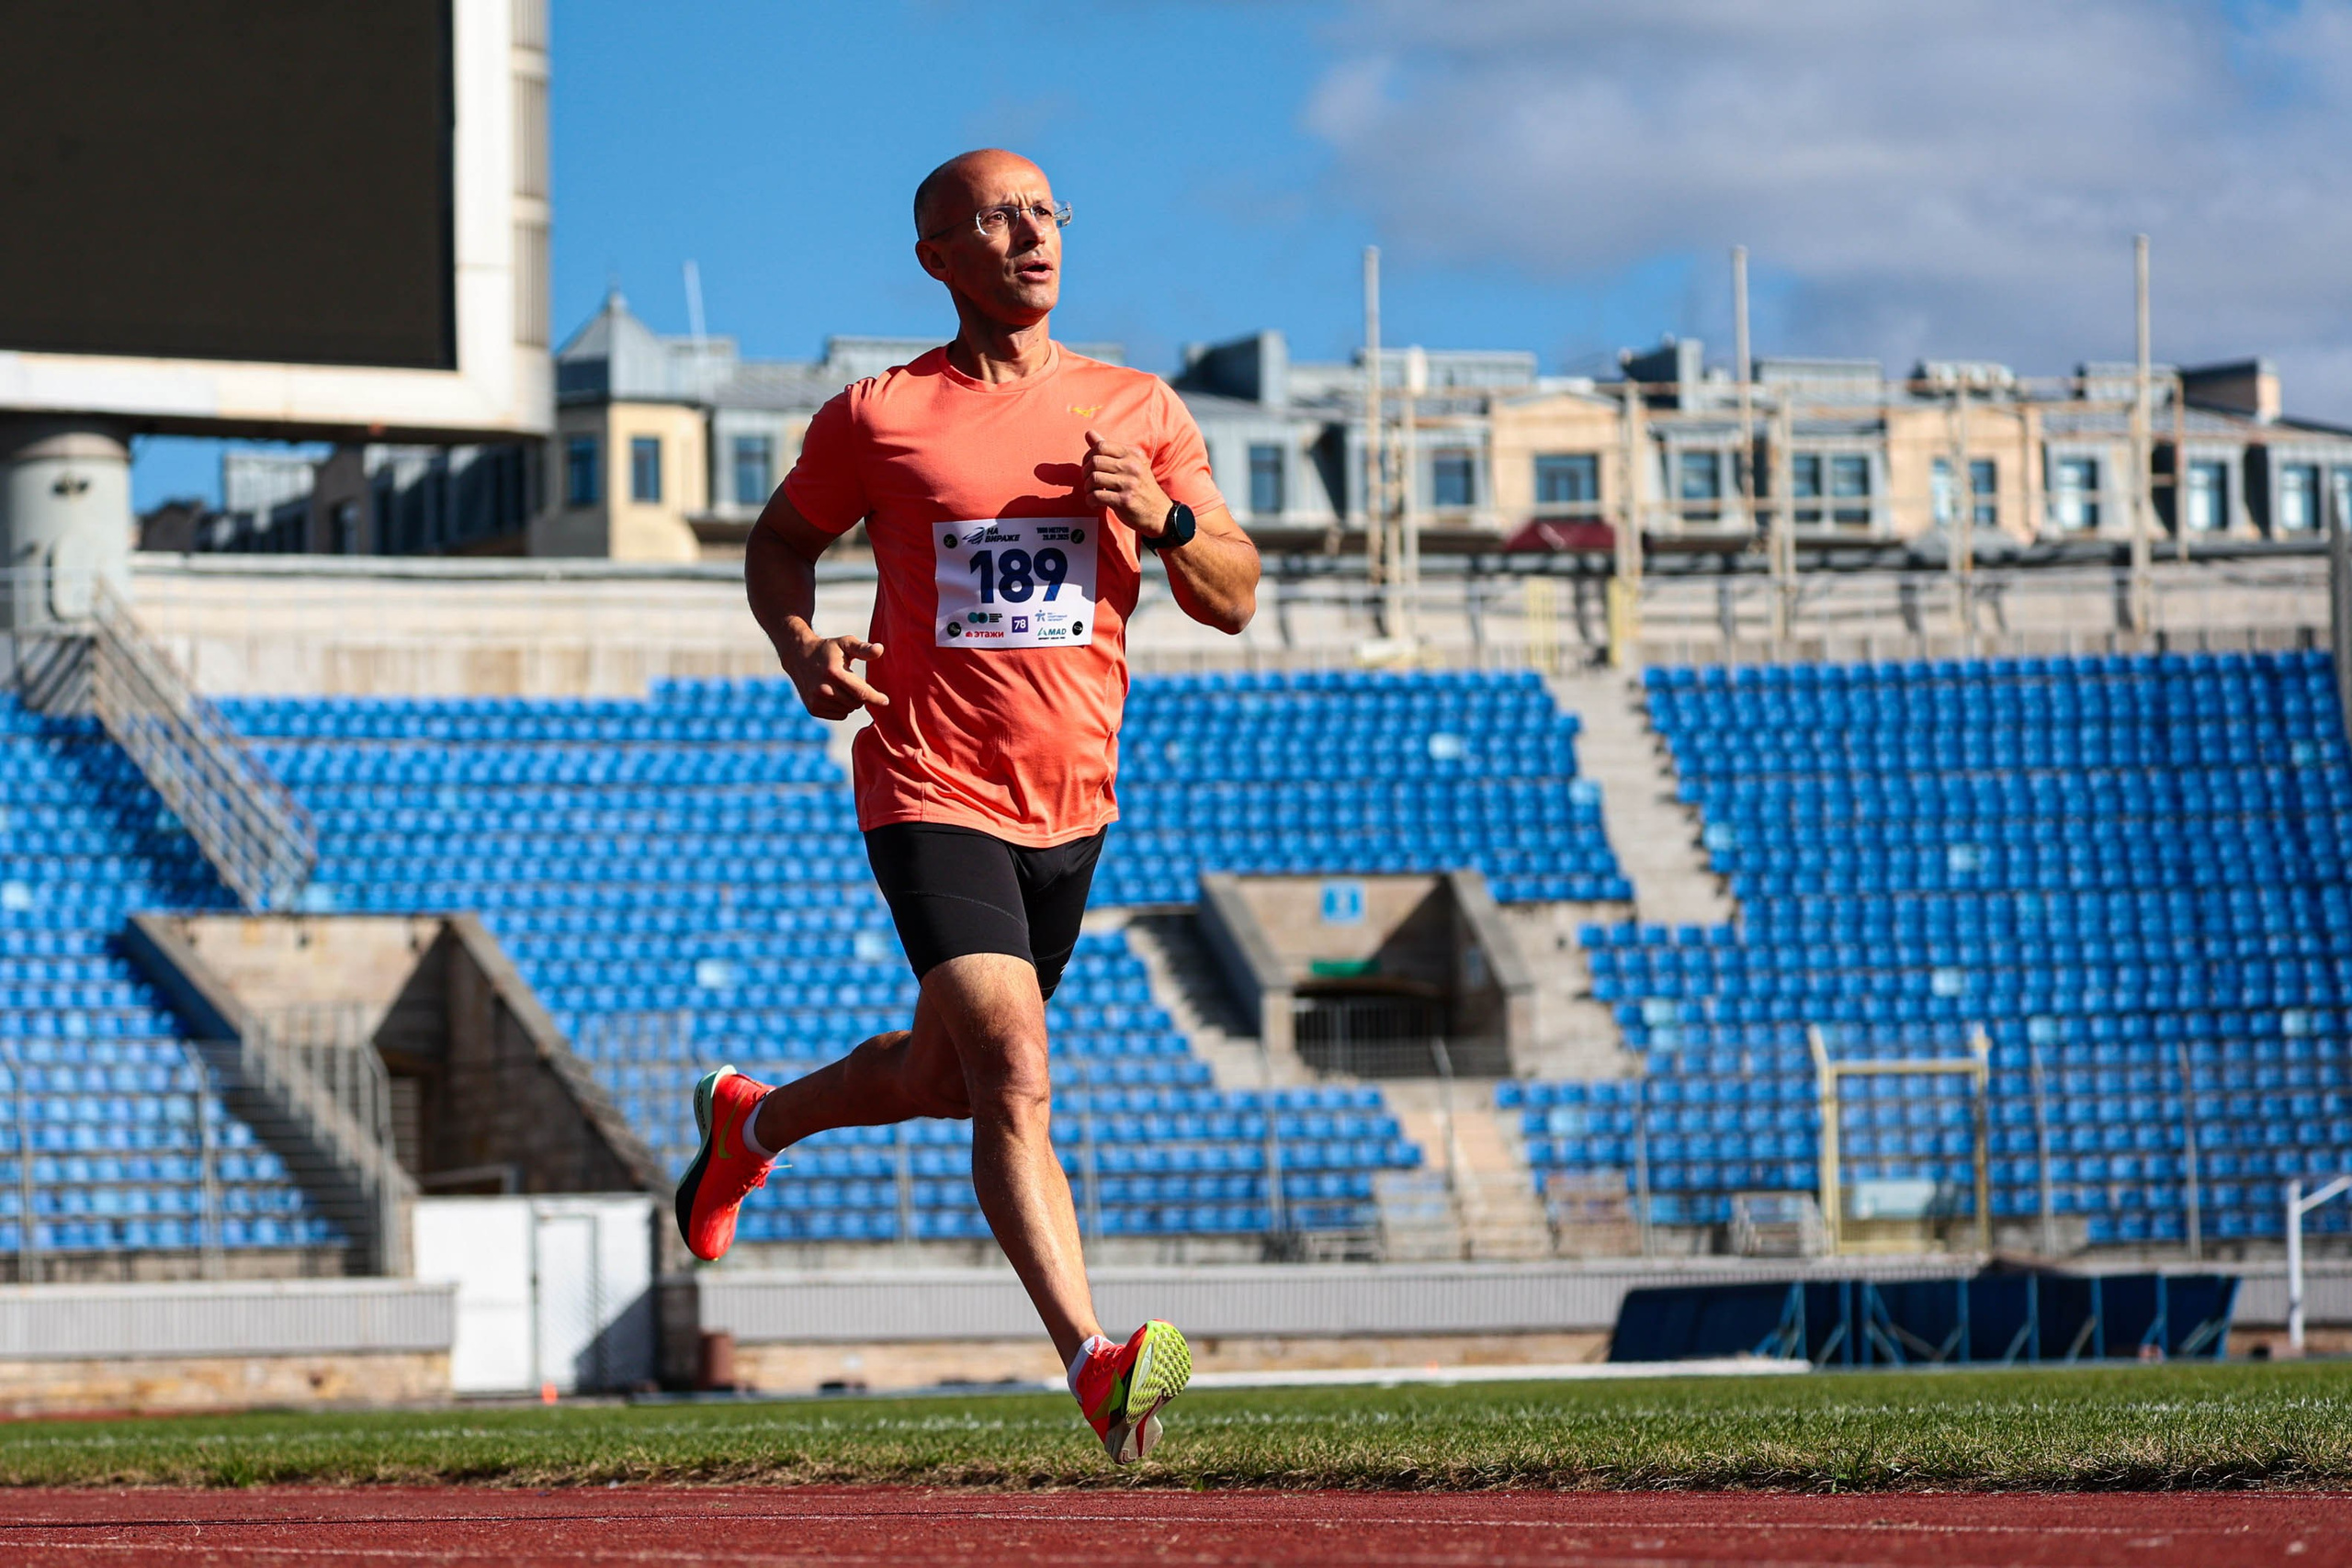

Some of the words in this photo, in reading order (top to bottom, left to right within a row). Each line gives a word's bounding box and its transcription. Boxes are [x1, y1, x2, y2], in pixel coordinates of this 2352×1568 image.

[985, 535, 1021, 543] ВИРАЖЕ
[969, 547, 1069, 604] 189
[1013, 619, 1026, 630] 78
